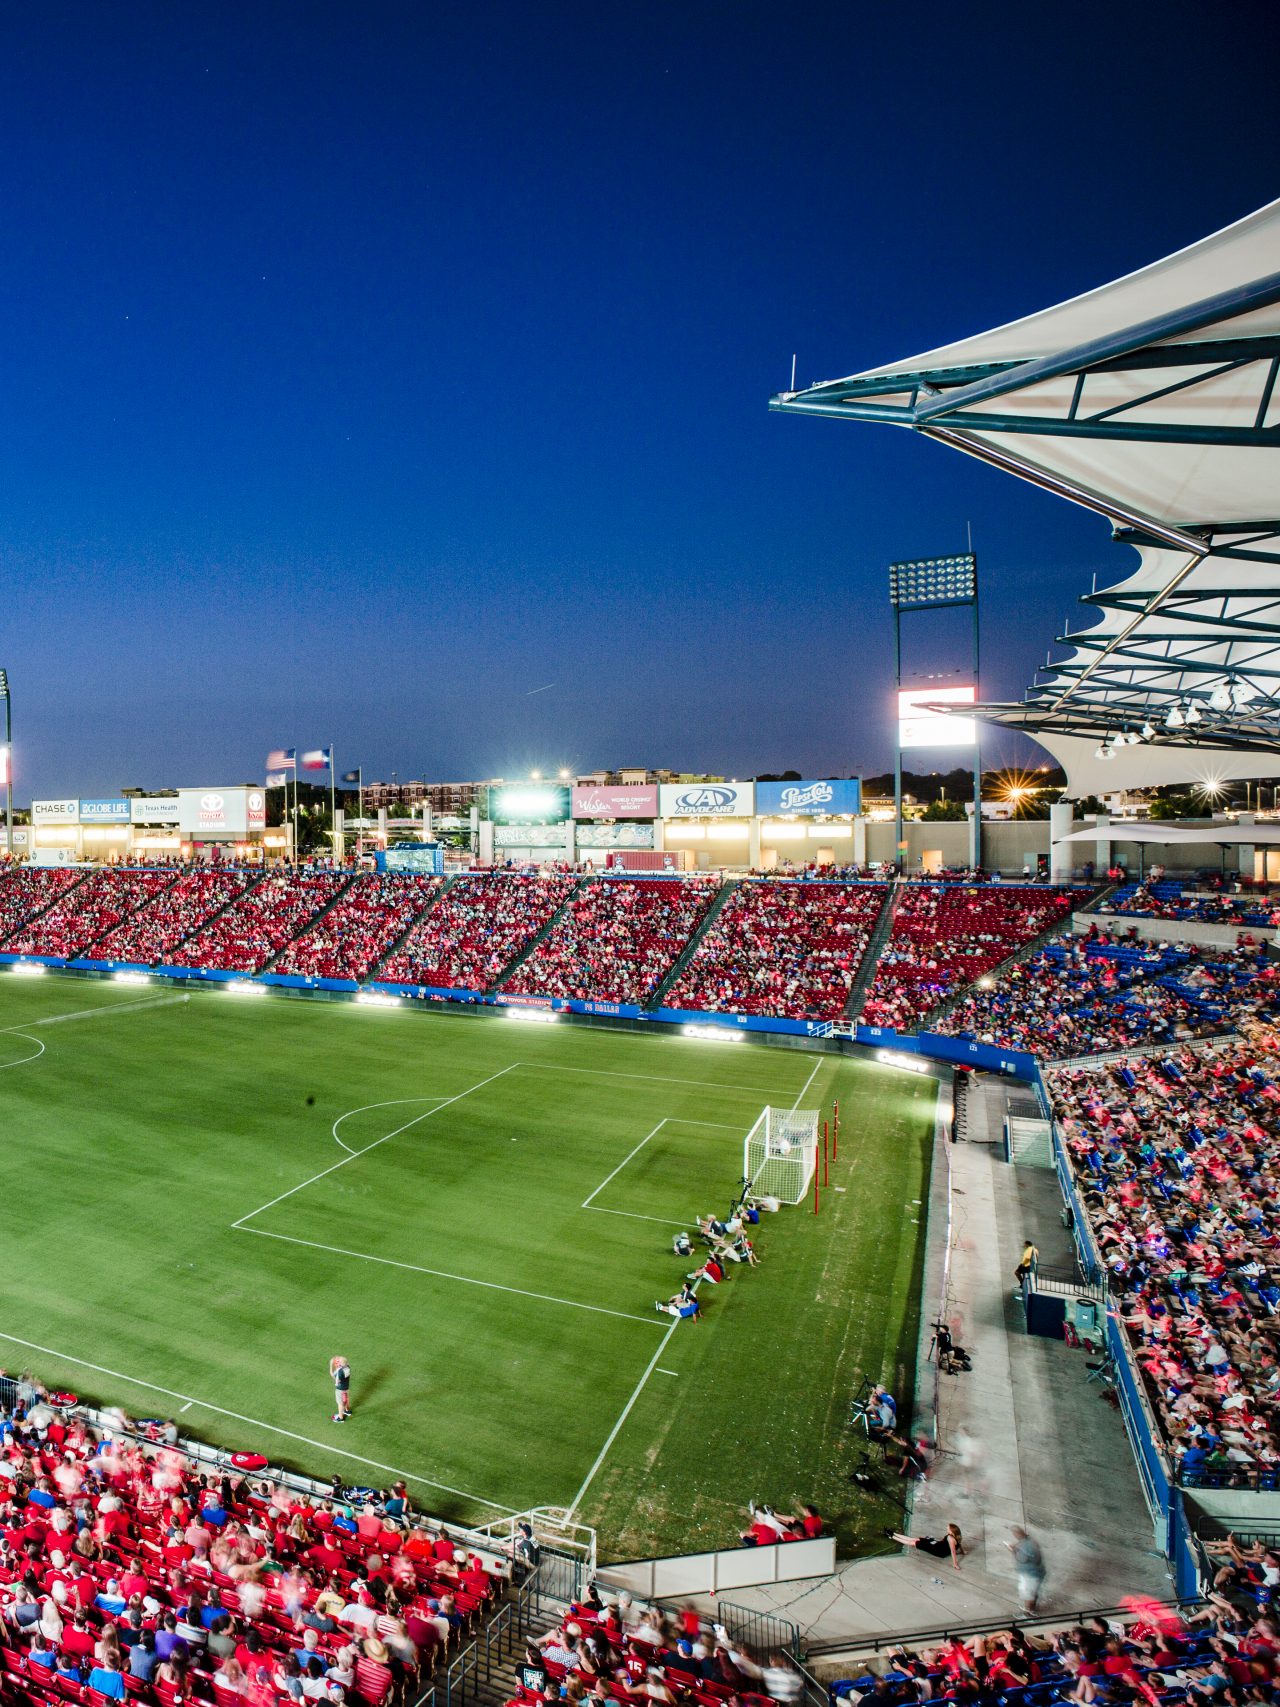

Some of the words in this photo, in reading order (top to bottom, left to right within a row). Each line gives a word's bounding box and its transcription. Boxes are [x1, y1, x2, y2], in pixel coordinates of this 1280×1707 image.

[35, 804, 66, 813] CHASE
[88, 803, 112, 813] GLOBE
[113, 803, 128, 813] LIFE
[675, 805, 736, 814] ADVOCARE
[200, 811, 225, 819] TOYOTA
[627, 1660, 643, 1674] 15
